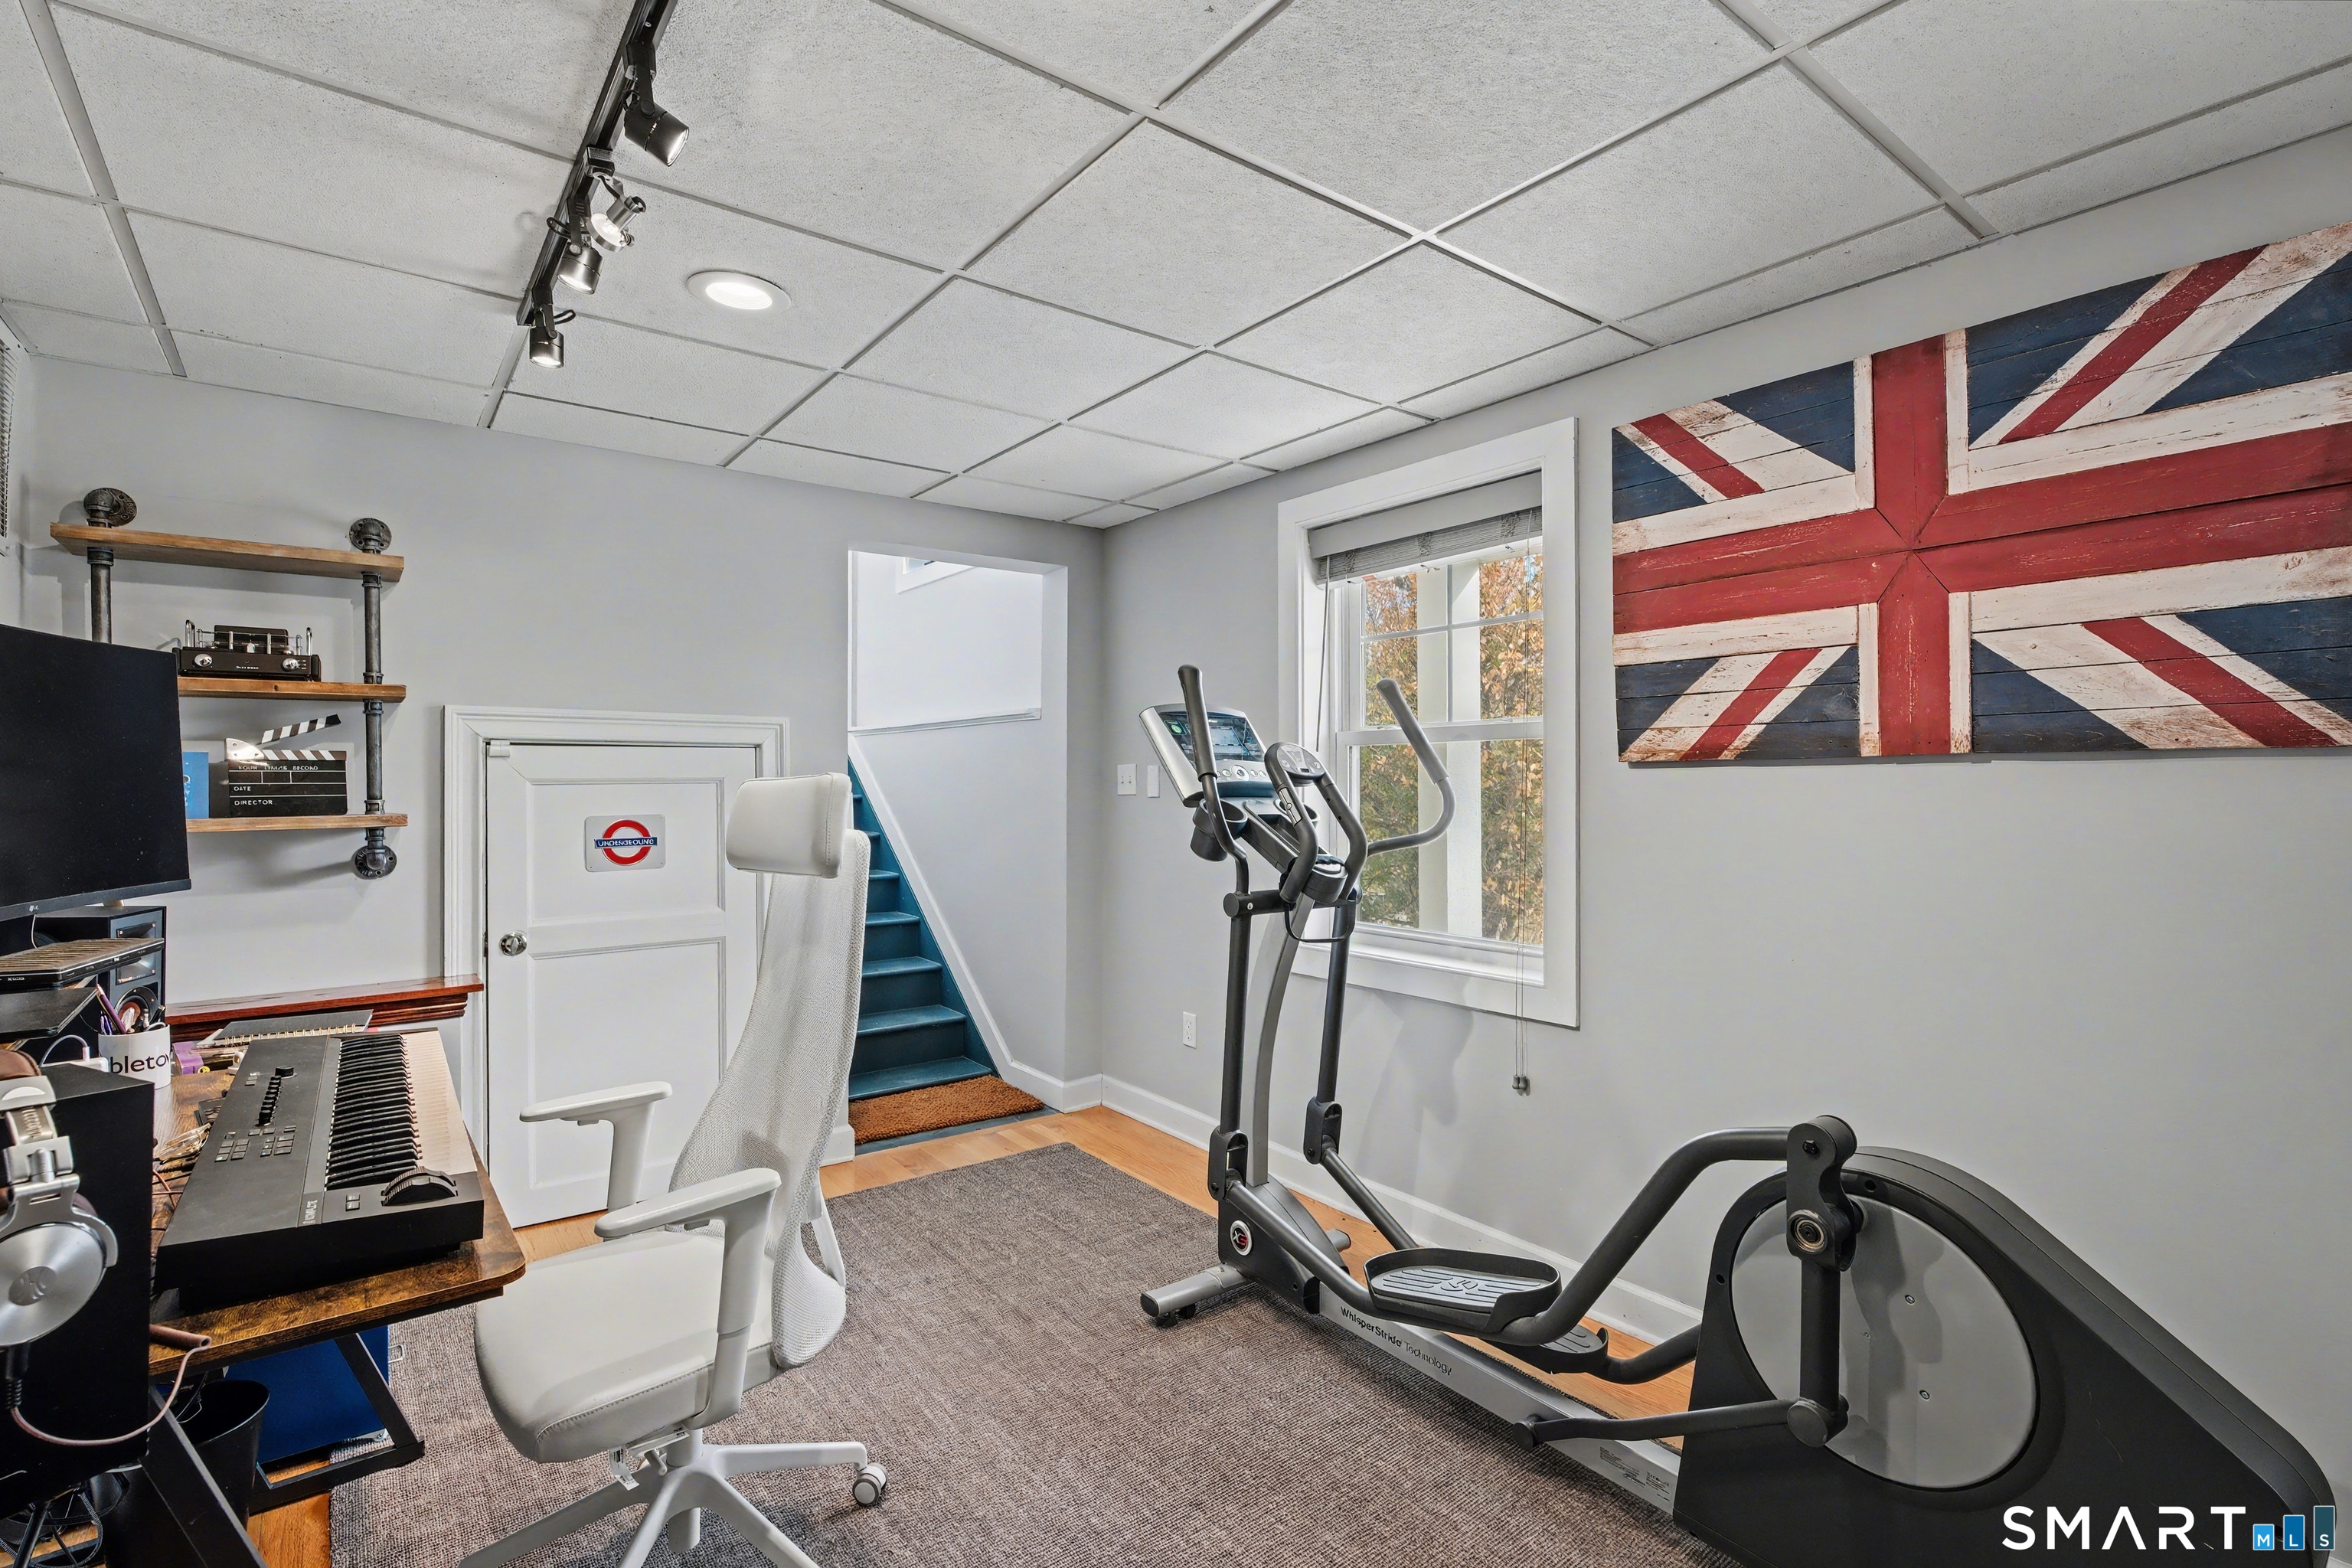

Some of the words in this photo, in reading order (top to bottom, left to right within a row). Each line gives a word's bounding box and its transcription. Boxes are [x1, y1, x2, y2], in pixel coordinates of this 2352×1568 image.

[99, 1052, 169, 1074] bleto
[1341, 1306, 1403, 1348] WhisperStride
[1404, 1341, 1452, 1376] Technology
